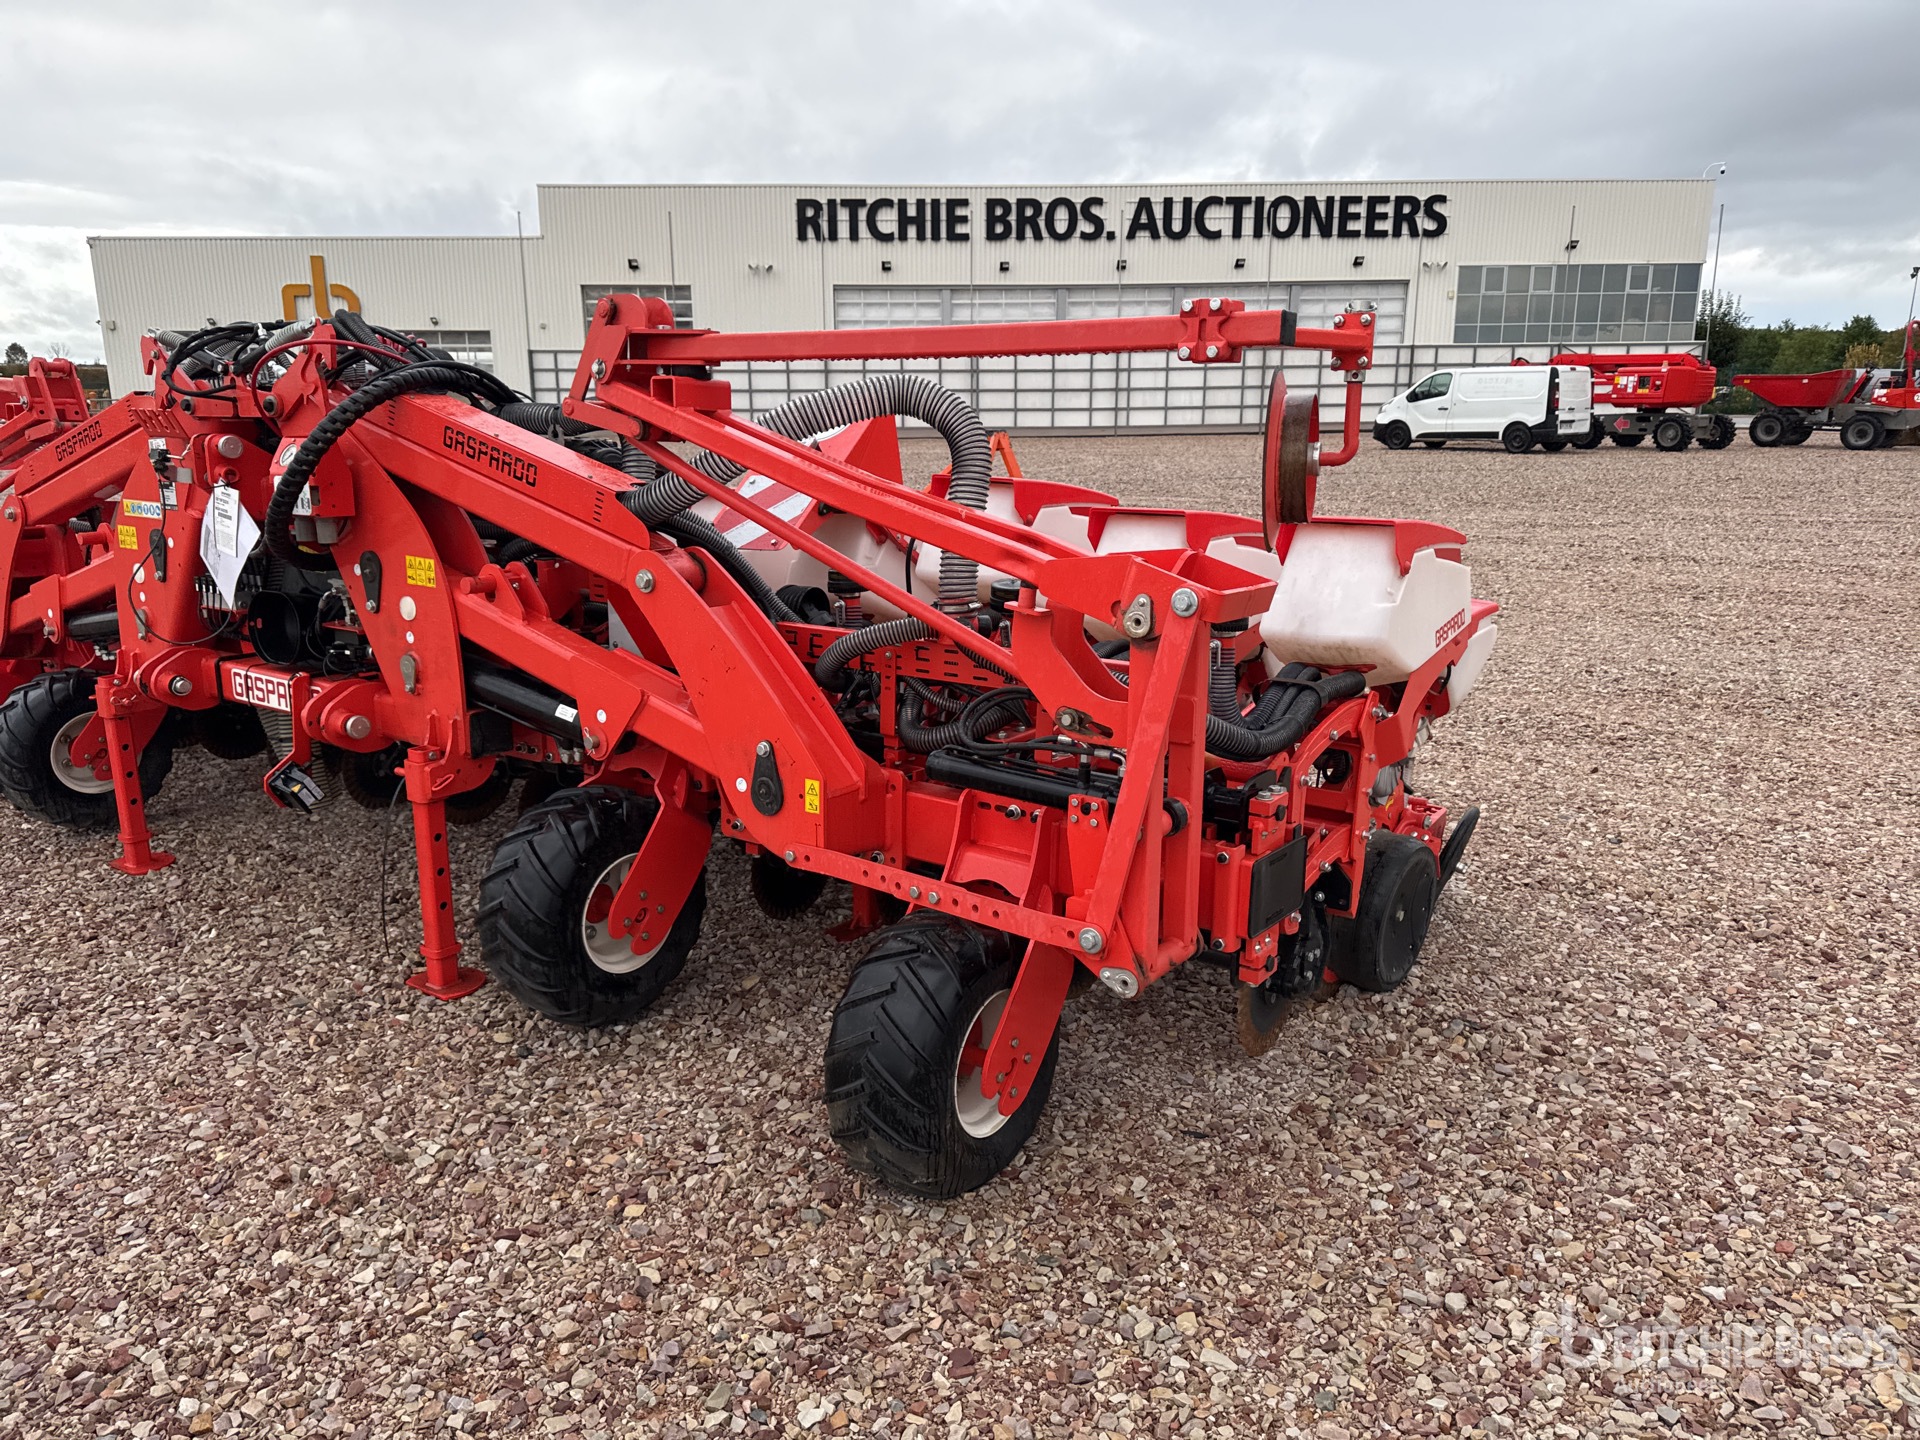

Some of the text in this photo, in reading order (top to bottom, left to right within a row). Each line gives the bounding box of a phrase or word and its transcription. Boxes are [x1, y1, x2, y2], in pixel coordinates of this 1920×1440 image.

[796, 195, 1448, 241] RITCHIE BROS. AUCTIONEERS
[55, 420, 102, 462] GASPARDO
[443, 425, 538, 488] GASPARDO
[1435, 607, 1465, 648] GASPARDO
